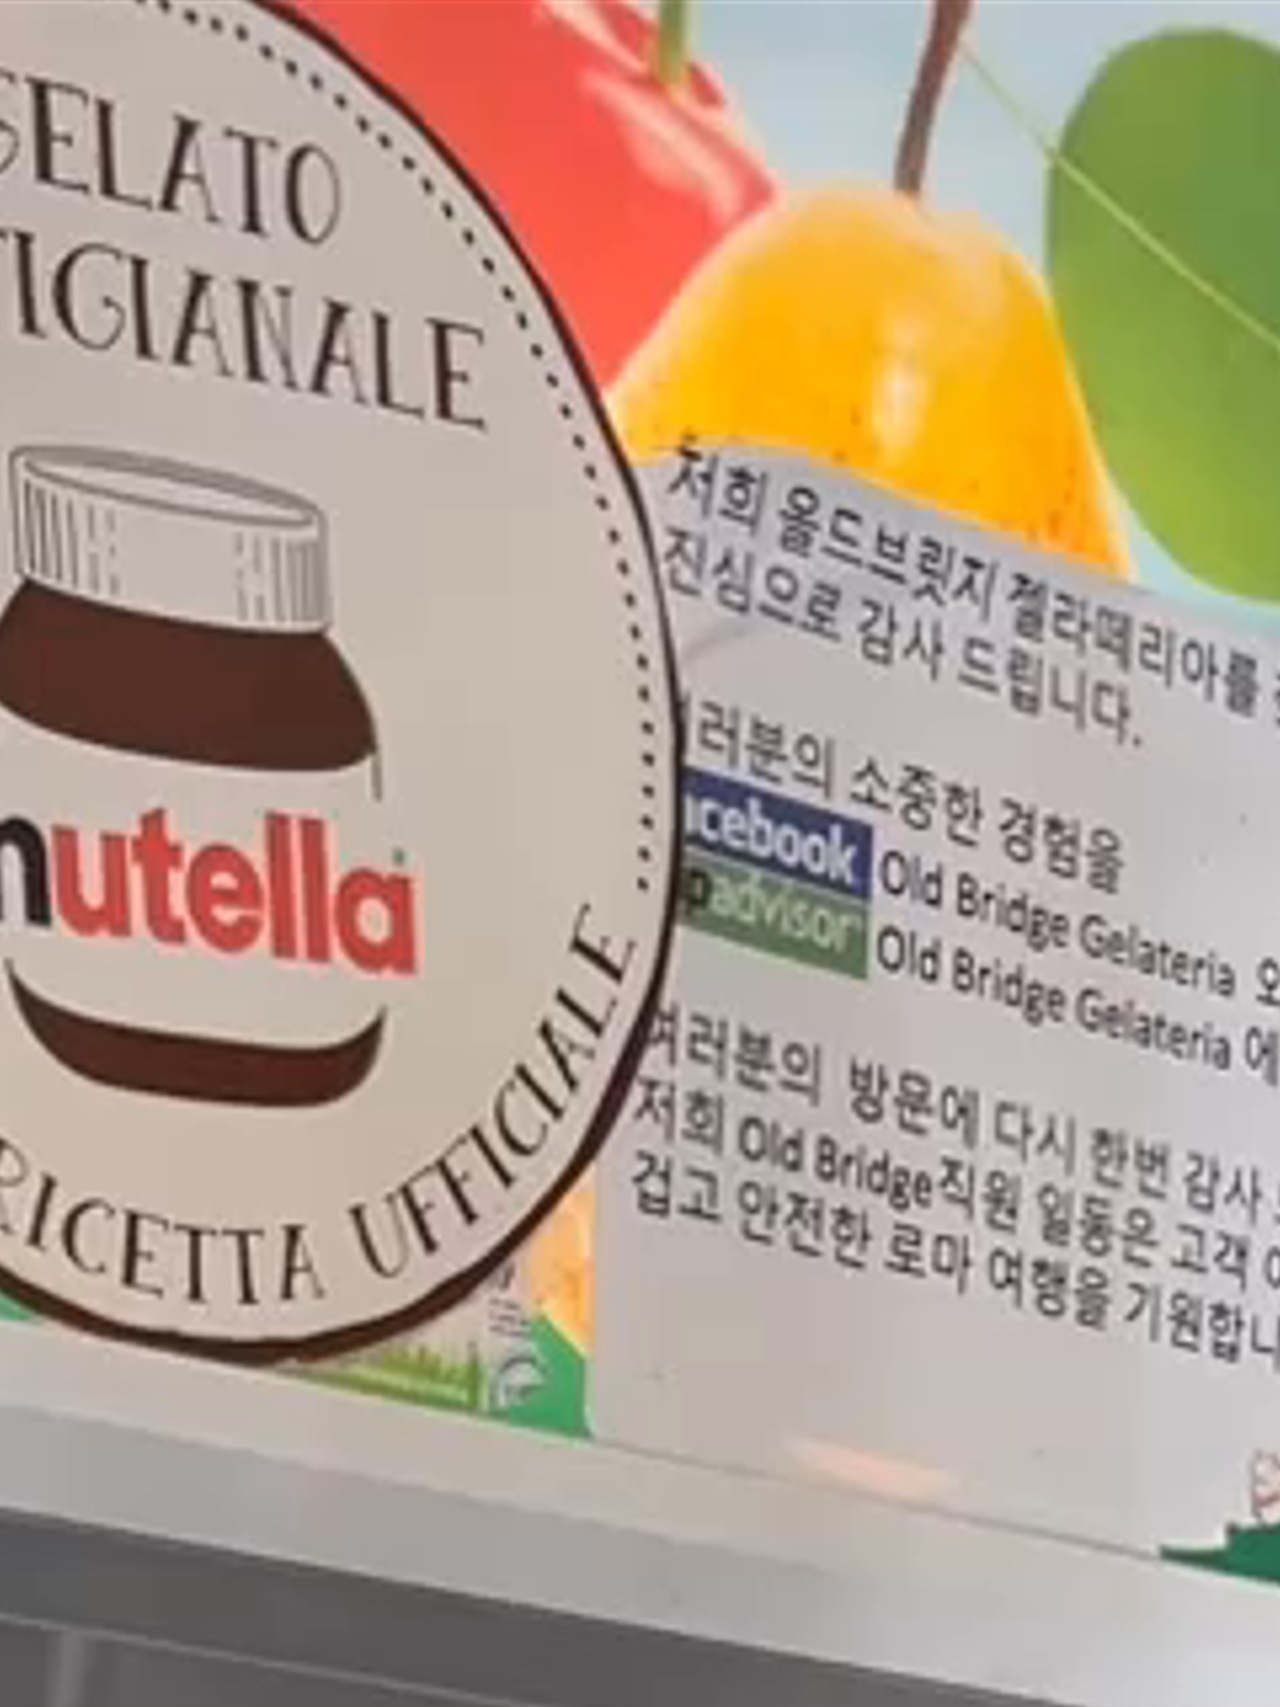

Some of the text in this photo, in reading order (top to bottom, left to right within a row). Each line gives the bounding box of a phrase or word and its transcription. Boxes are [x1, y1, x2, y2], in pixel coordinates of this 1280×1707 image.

[667, 447, 767, 533] 저희
[778, 486, 997, 619] 올드브릿지
[665, 527, 1142, 749] 진심으로 감사 드립니다.
[684, 693, 1124, 894] 러분의 소중한 경험을
[684, 792, 862, 884] cebook
[879, 849, 942, 908] Old
[956, 869, 1072, 955] Bridge
[1077, 912, 1237, 995] Gelateria
[348, 902, 636, 1280] UFFICIALE
[876, 923, 937, 988] Old
[951, 947, 1066, 1027] Bridge
[1074, 984, 1233, 1070] Gelateria
[1242, 1026, 1280, 1088] 에
[631, 1152, 721, 1222] 겁고
[738, 1183, 871, 1271] 안전한
[882, 1226, 974, 1296] 로마
[988, 1248, 1109, 1331] 여행을
[634, 1073, 722, 1154] 저희
[738, 1115, 804, 1174] Old
[1036, 1185, 1158, 1273] 일동은
[1172, 1232, 1251, 1295] 고객
[847, 1056, 980, 1146] 방문에
[992, 1095, 1076, 1174] 다시
[1088, 1126, 1170, 1201] 한번
[1181, 1154, 1263, 1227] 감사
